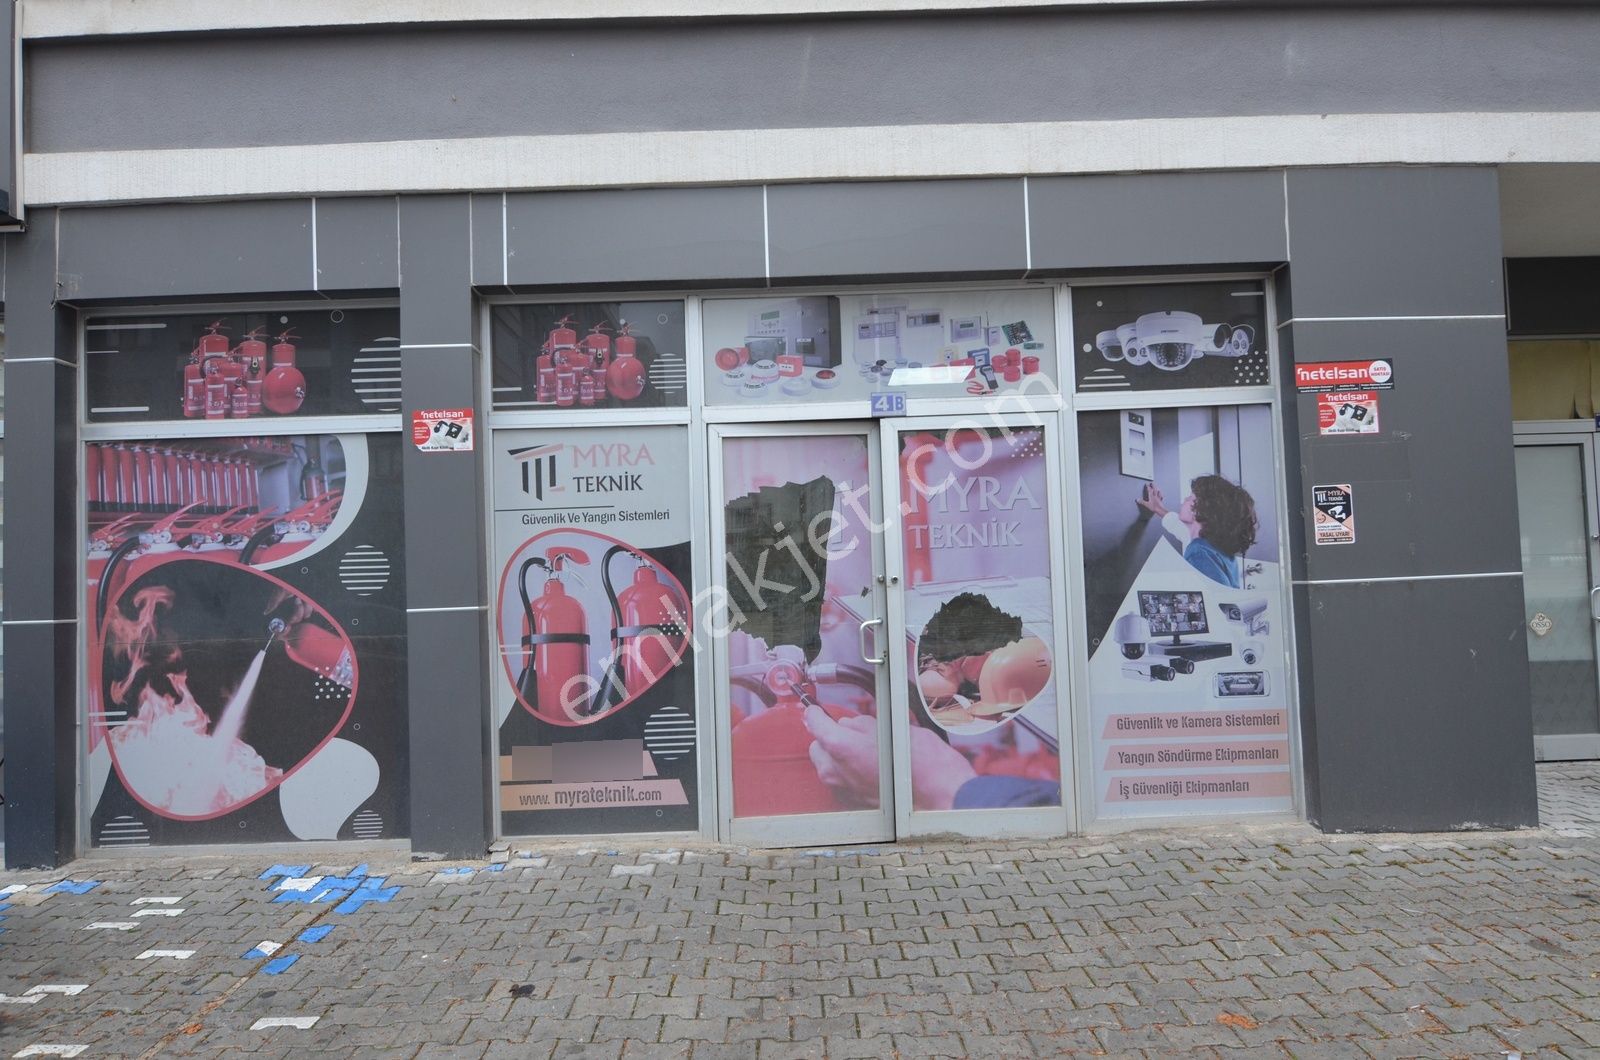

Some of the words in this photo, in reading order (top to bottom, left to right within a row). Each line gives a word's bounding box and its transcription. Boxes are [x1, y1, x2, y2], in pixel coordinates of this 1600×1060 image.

[1297, 366, 1368, 381] netelsan
[1325, 393, 1368, 402] netelsan
[421, 410, 464, 419] netelsan
[571, 443, 655, 468] MYRA
[573, 472, 643, 493] TEKNİK
[907, 475, 1042, 513] MYRA
[521, 511, 566, 525] Güvenlik
[567, 512, 581, 523] Ve
[583, 511, 616, 525] Yangın
[618, 509, 670, 522] Sistemleri
[907, 518, 1023, 549] TEKNİK
[1116, 716, 1163, 730] Güvenlik
[1166, 719, 1178, 728] ve
[1181, 715, 1222, 728] Kamera
[1225, 713, 1280, 727] Sistemleri
[1118, 751, 1154, 766] Yangın
[1157, 748, 1212, 763] Söndürme
[1215, 747, 1279, 763] Ekipmanları
[1119, 780, 1129, 799] İş
[1133, 780, 1183, 796] Güvenliği
[1185, 779, 1249, 796] Ekipmanları
